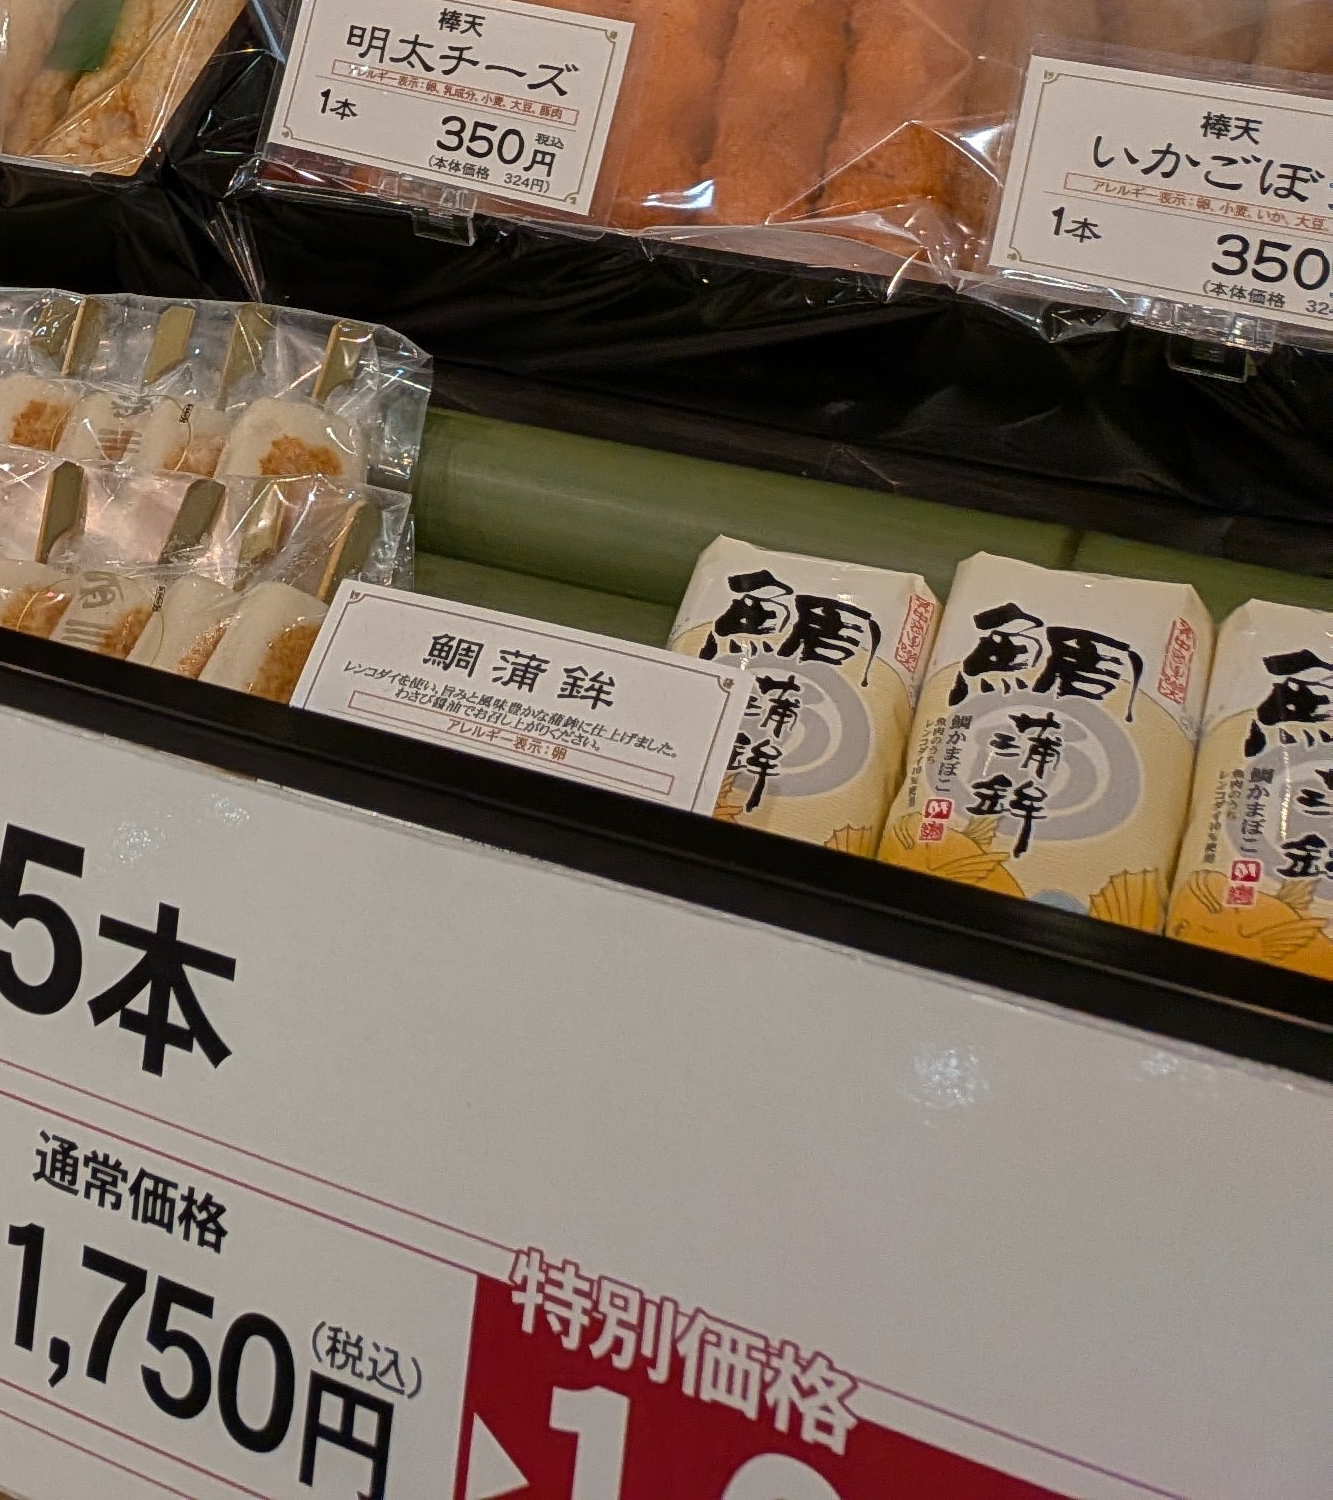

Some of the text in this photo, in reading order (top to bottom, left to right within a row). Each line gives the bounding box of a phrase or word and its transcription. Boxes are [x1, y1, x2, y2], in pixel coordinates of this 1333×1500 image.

[345, 25, 581, 97] 明太チーズ
[438, 7, 487, 39] 棒天
[319, 88, 565, 178] 1本 350円 税込
[1200, 111, 1264, 145] 棒天
[428, 154, 551, 195] (本体価格 324円)
[1093, 135, 1333, 211] いかごぼ
[1051, 206, 1333, 302] 1本 350
[1202, 278, 1287, 309] (本体価格
[421, 631, 617, 711] 鯛蒲鉾
[936, 714, 973, 793] 鯛かまぼこ
[1239, 767, 1276, 854] 鯛かまぼこ
[32, 1129, 231, 1256] 通常価格
[6, 1221, 396, 1500] 1,750円
[309, 1319, 424, 1401] (税込)
[509, 1246, 862, 1458] 特別価格
